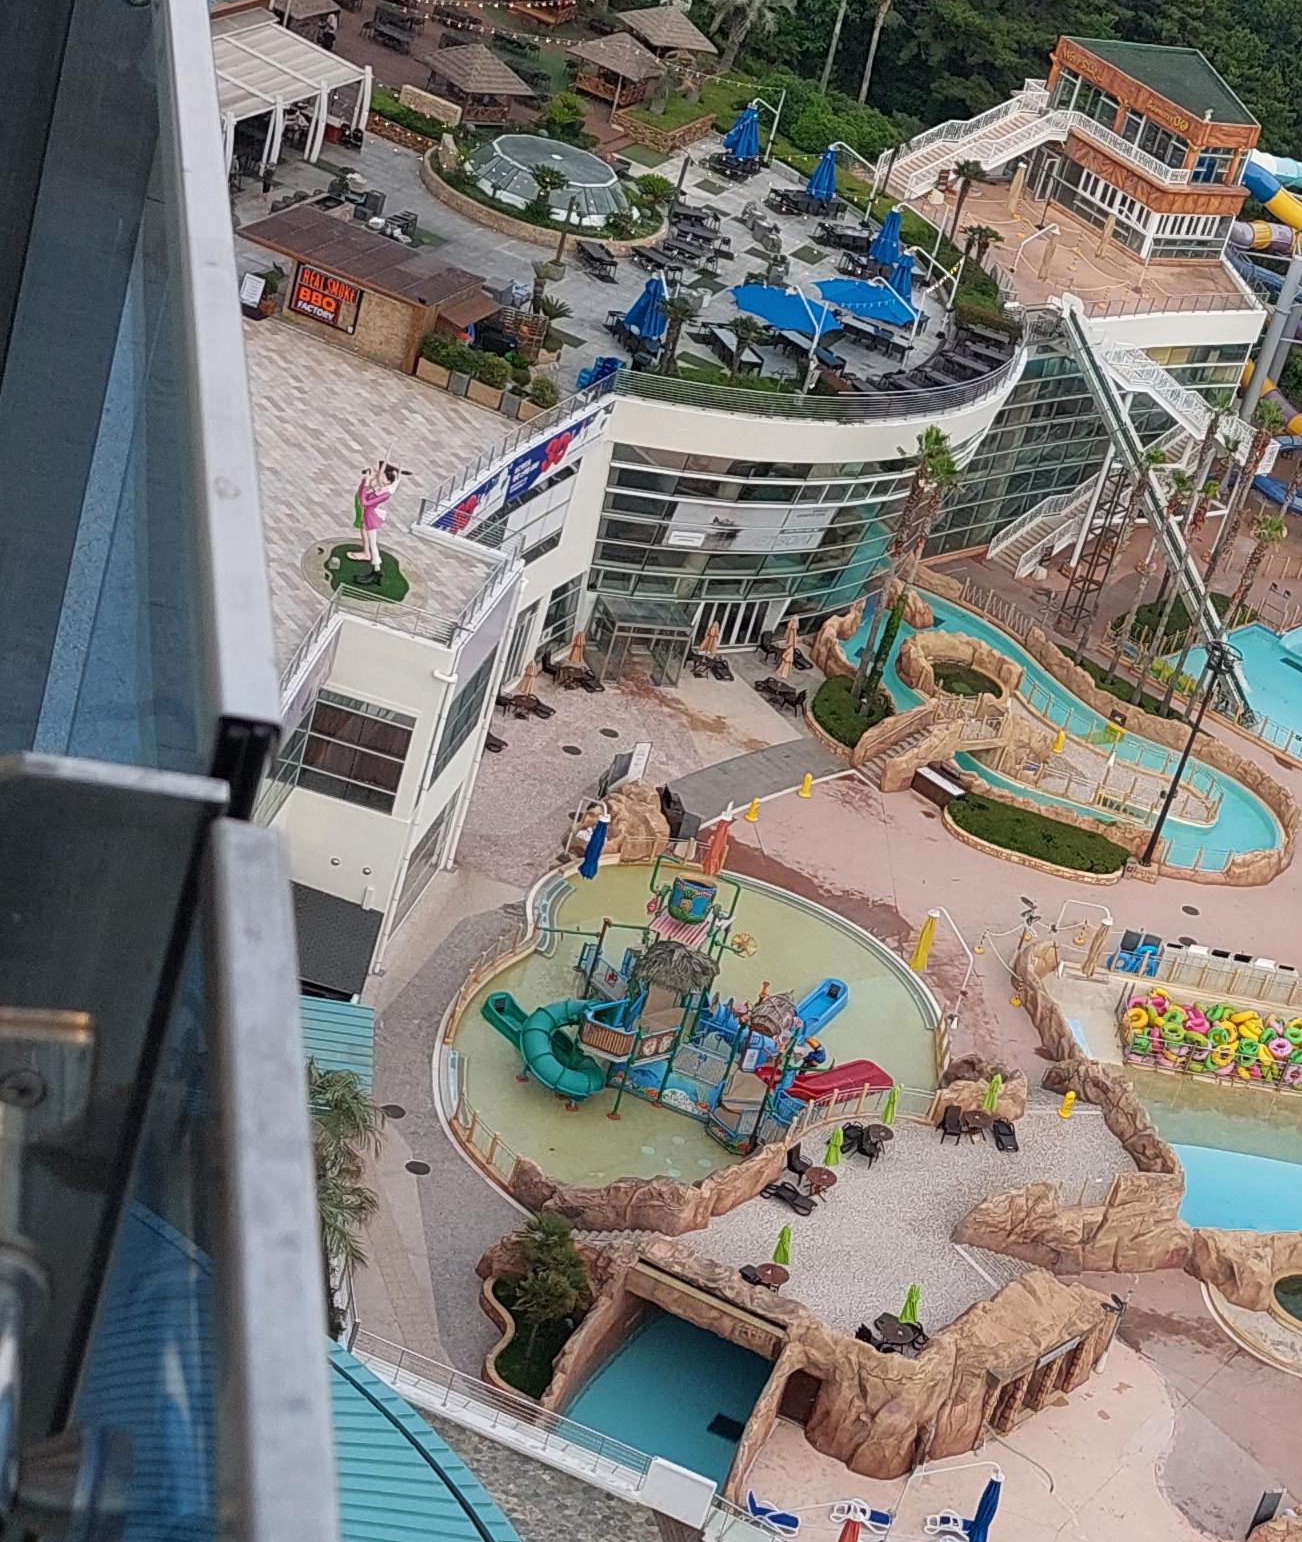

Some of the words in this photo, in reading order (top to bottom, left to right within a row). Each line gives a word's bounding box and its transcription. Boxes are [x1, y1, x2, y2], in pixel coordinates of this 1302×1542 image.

[298, 286, 337, 312] BBQ
[301, 268, 325, 292] REAL
[326, 277, 357, 305] SMOKE
[296, 300, 335, 321] FACTORY
